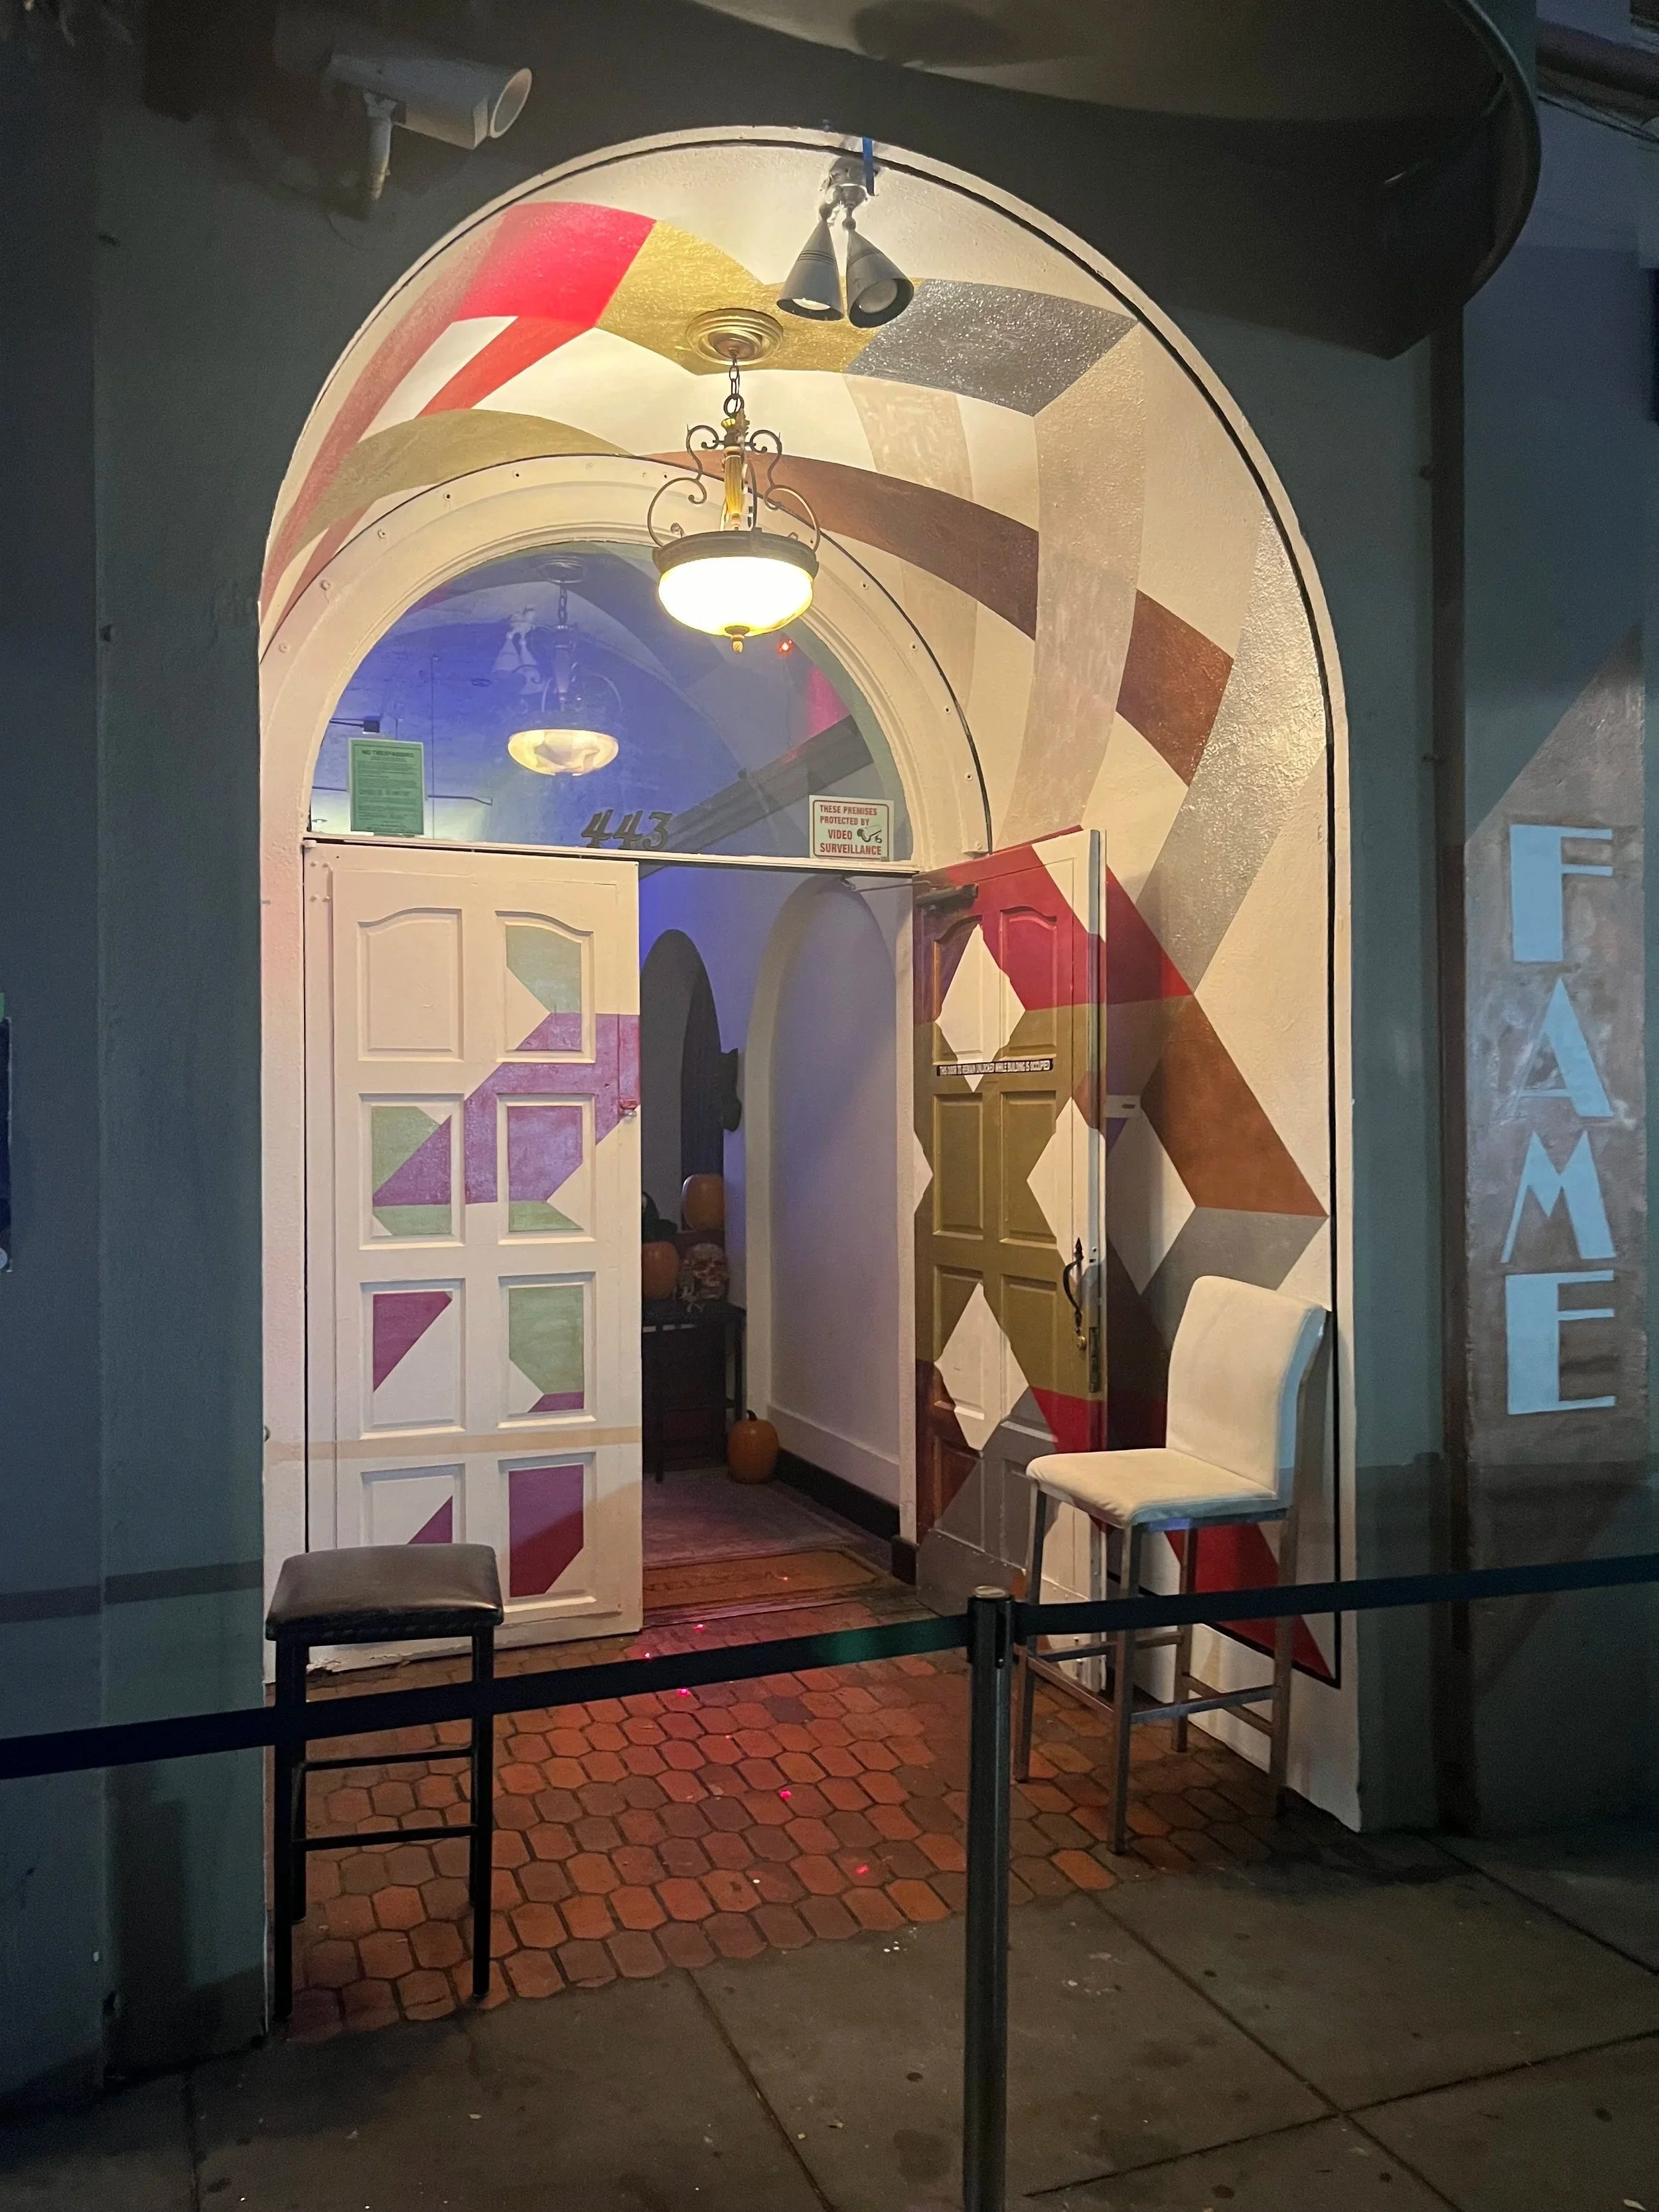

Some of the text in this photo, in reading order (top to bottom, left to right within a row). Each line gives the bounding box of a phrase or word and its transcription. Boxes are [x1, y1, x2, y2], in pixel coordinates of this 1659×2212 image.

[820, 804, 877, 816] THESE PREMISES
[820, 816, 858, 826] PROTECTED
[581, 809, 673, 850] 443
[828, 829, 852, 840] VIDEO
[820, 843, 881, 855] SURVEILLANCE
[1499, 824, 1617, 1415] FAME
